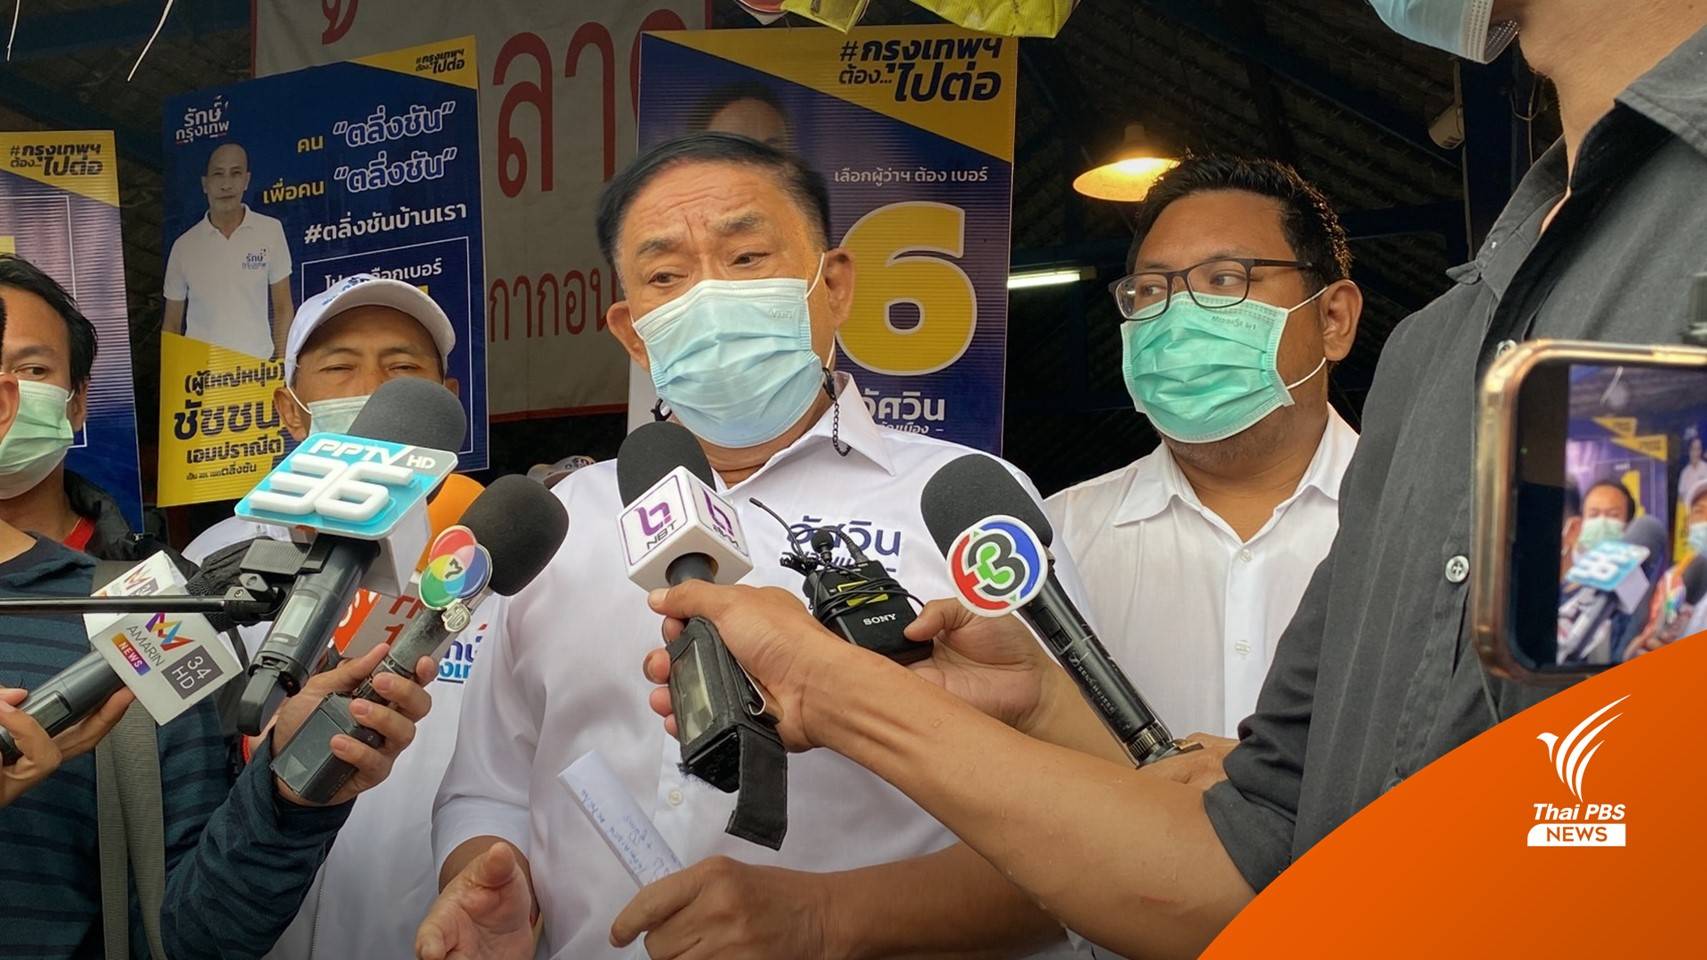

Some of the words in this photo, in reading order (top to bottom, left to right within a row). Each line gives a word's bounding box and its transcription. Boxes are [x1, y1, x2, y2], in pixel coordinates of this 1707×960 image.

[840, 38, 1003, 74] #กรุงเทพฯ
[895, 61, 1002, 102] ไปต่อ
[175, 120, 230, 143] กรุงเทพ
[297, 135, 324, 153] คน
[43, 155, 104, 176] ไปต่อ
[834, 167, 910, 187] เลือกผู้ว่าฯ
[915, 167, 947, 182] ต้อง
[951, 166, 989, 182] เบอร์
[263, 178, 325, 204] เพื่อคน
[304, 203, 467, 244] #ตลิ่งชันบ้านเรา
[836, 201, 978, 376] 6
[186, 434, 283, 464] เอมปราณีต
[311, 439, 411, 465] PPTV
[406, 454, 436, 470] HD
[250, 453, 413, 522] 36
[646, 520, 677, 550] NBT
[967, 533, 1026, 597] 3
[863, 613, 897, 626] SONY
[118, 641, 144, 669] NEWS
[126, 625, 166, 667] AMARIN
[172, 666, 196, 690] HD
[187, 656, 213, 680] 34
